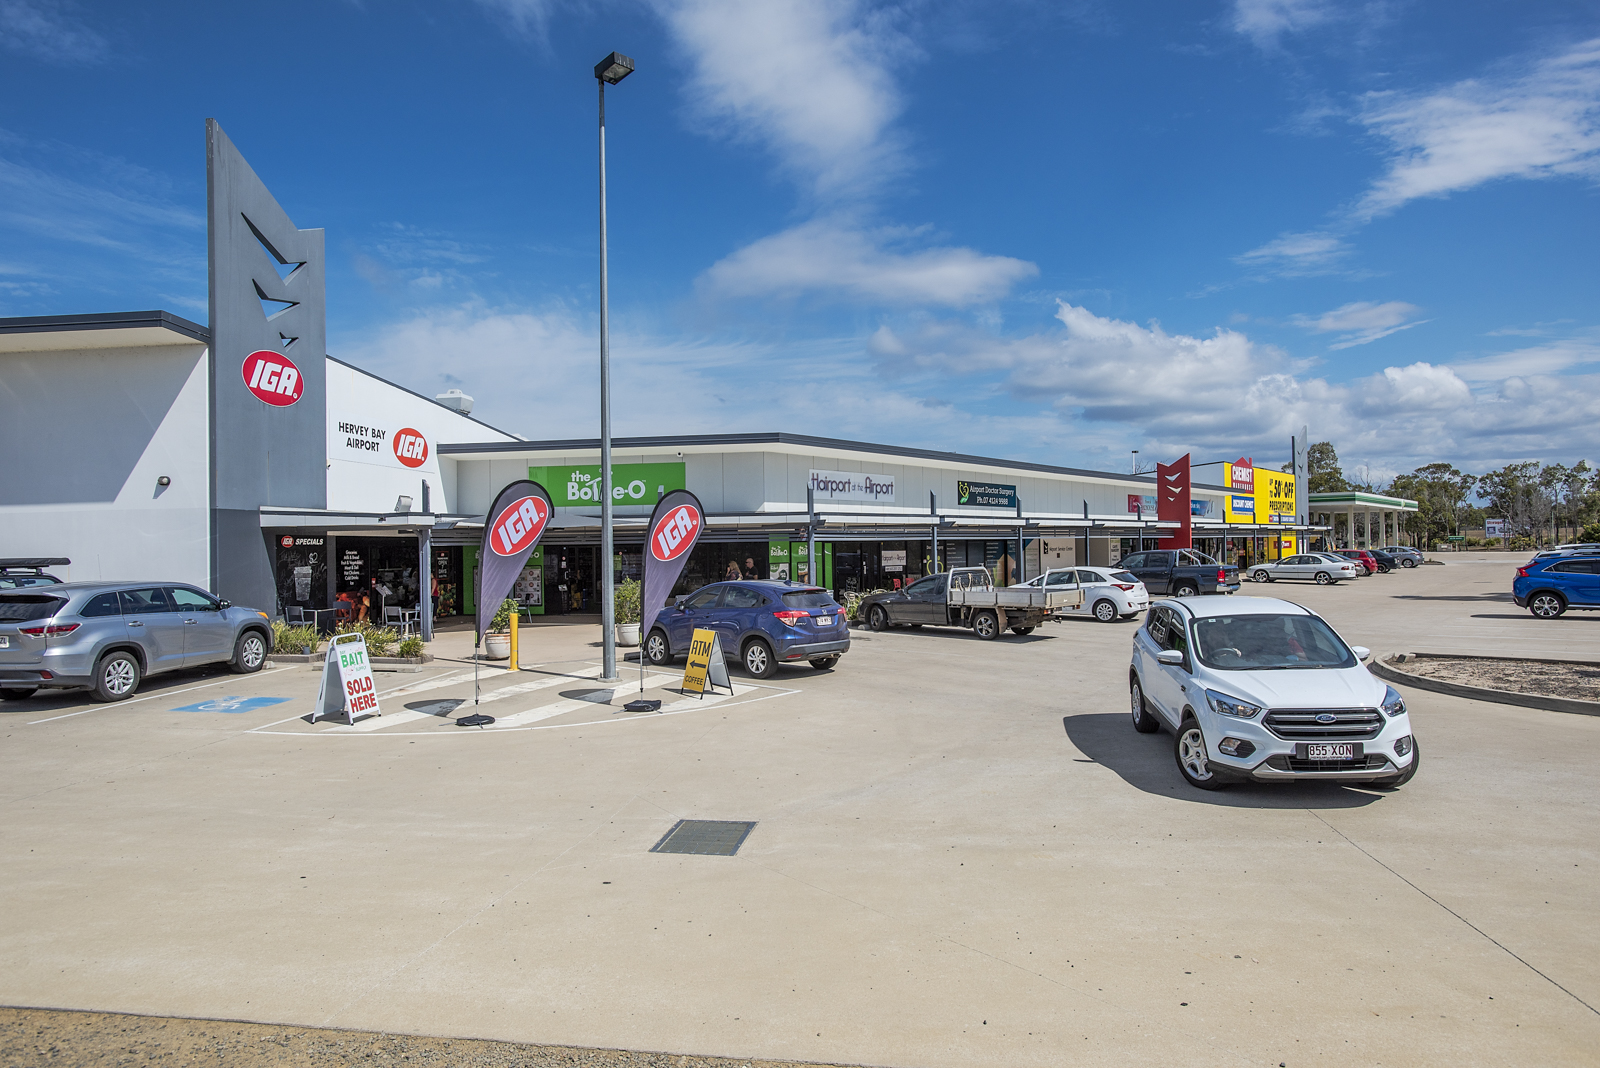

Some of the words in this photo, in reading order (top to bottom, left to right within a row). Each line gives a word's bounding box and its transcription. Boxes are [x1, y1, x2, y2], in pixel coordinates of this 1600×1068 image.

[249, 359, 298, 397] IGA
[338, 422, 369, 438] HERVEY
[372, 428, 386, 440] BAY
[346, 438, 380, 452] AIRPORT
[396, 434, 425, 460] IGA
[571, 471, 590, 482] the
[1232, 466, 1252, 482] CHEMIST
[567, 480, 646, 502] Bote-O
[811, 472, 851, 498] Hairport
[865, 476, 894, 500] Airport
[970, 485, 984, 494] Airport
[999, 488, 1014, 496] Surgery
[1284, 481, 1294, 498] OFF
[1269, 500, 1294, 511] PRESCRIPTIONS
[498, 498, 540, 553] IGA
[657, 507, 693, 558] IGA
[691, 640, 711, 657] ATM
[341, 651, 363, 668] BAIT
[346, 676, 372, 696] SOLD
[685, 674, 704, 686] COFFEE
[350, 693, 377, 713] HERE
